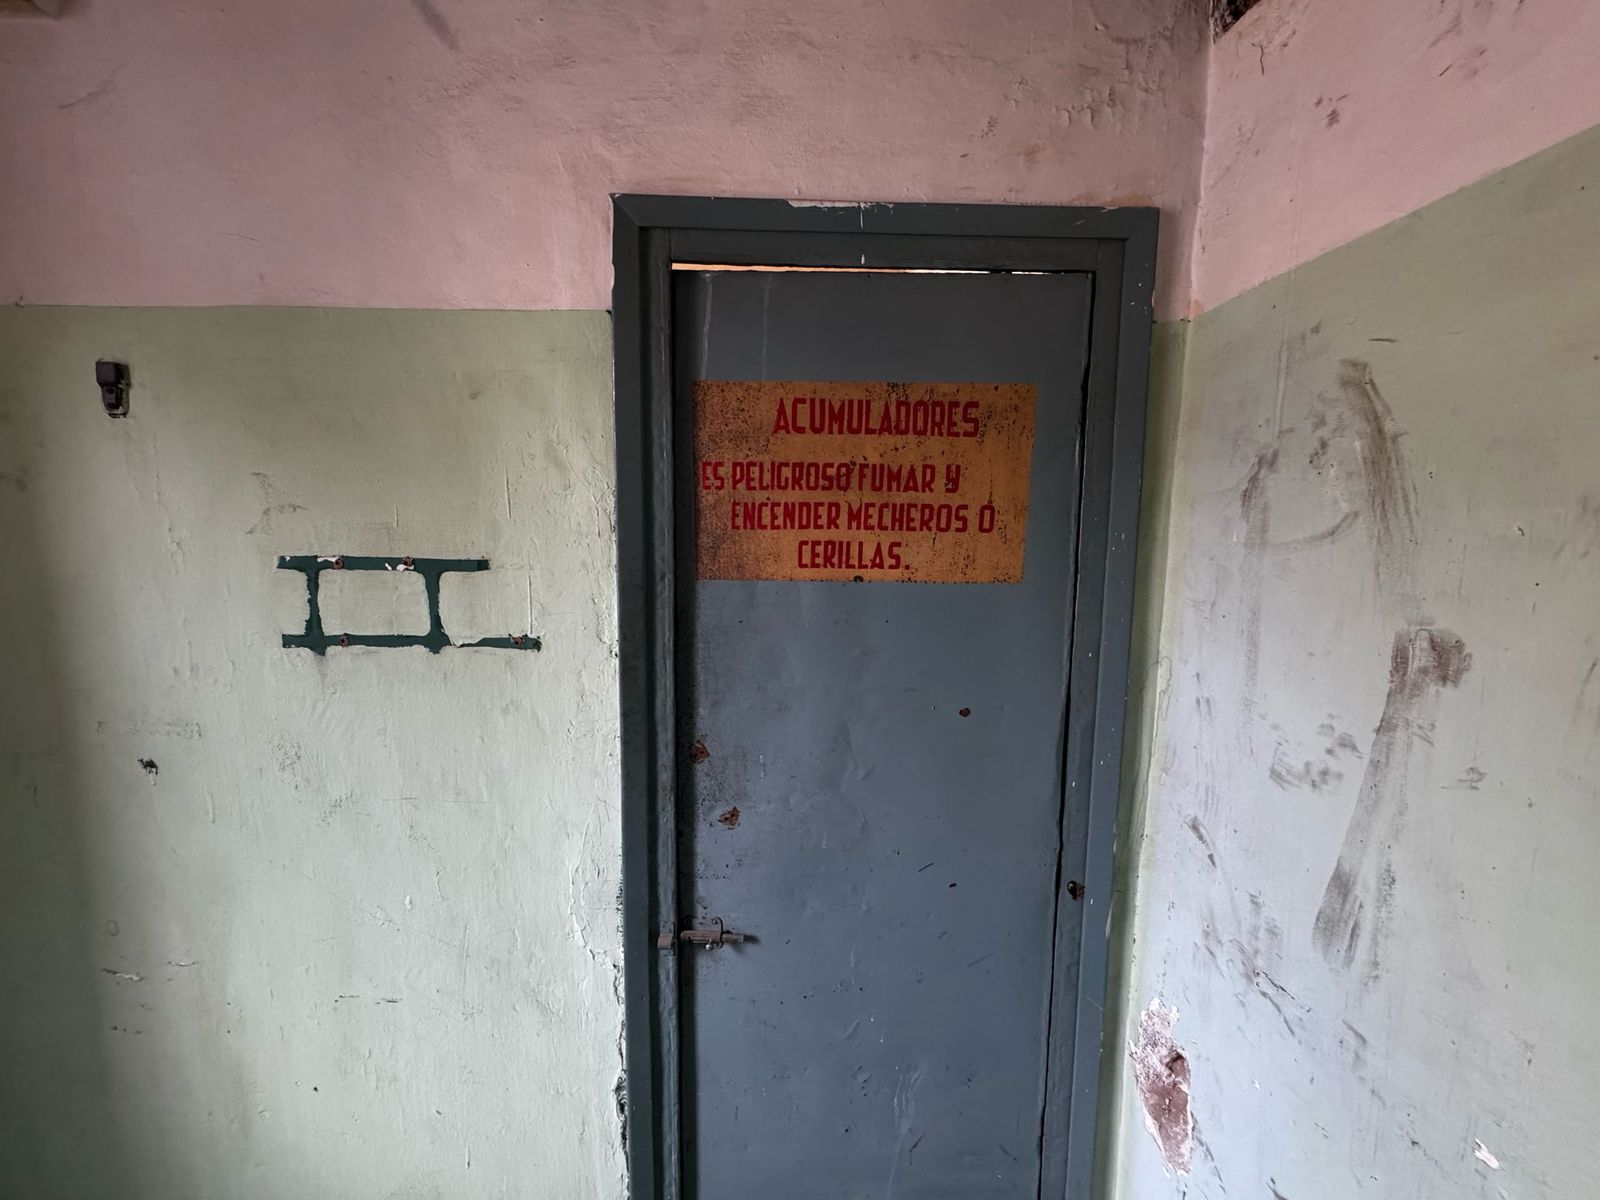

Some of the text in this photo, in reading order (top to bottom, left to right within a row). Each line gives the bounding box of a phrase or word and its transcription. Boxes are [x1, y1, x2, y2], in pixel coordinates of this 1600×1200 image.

[773, 398, 980, 437] ACUMULADORES
[701, 462, 725, 490] ES
[732, 461, 851, 492] PELIGROSO
[857, 464, 935, 493] FUMAR
[731, 500, 840, 530] ENCENDER
[847, 502, 968, 532] MECHEROS
[797, 540, 911, 570] CERILLAS.
